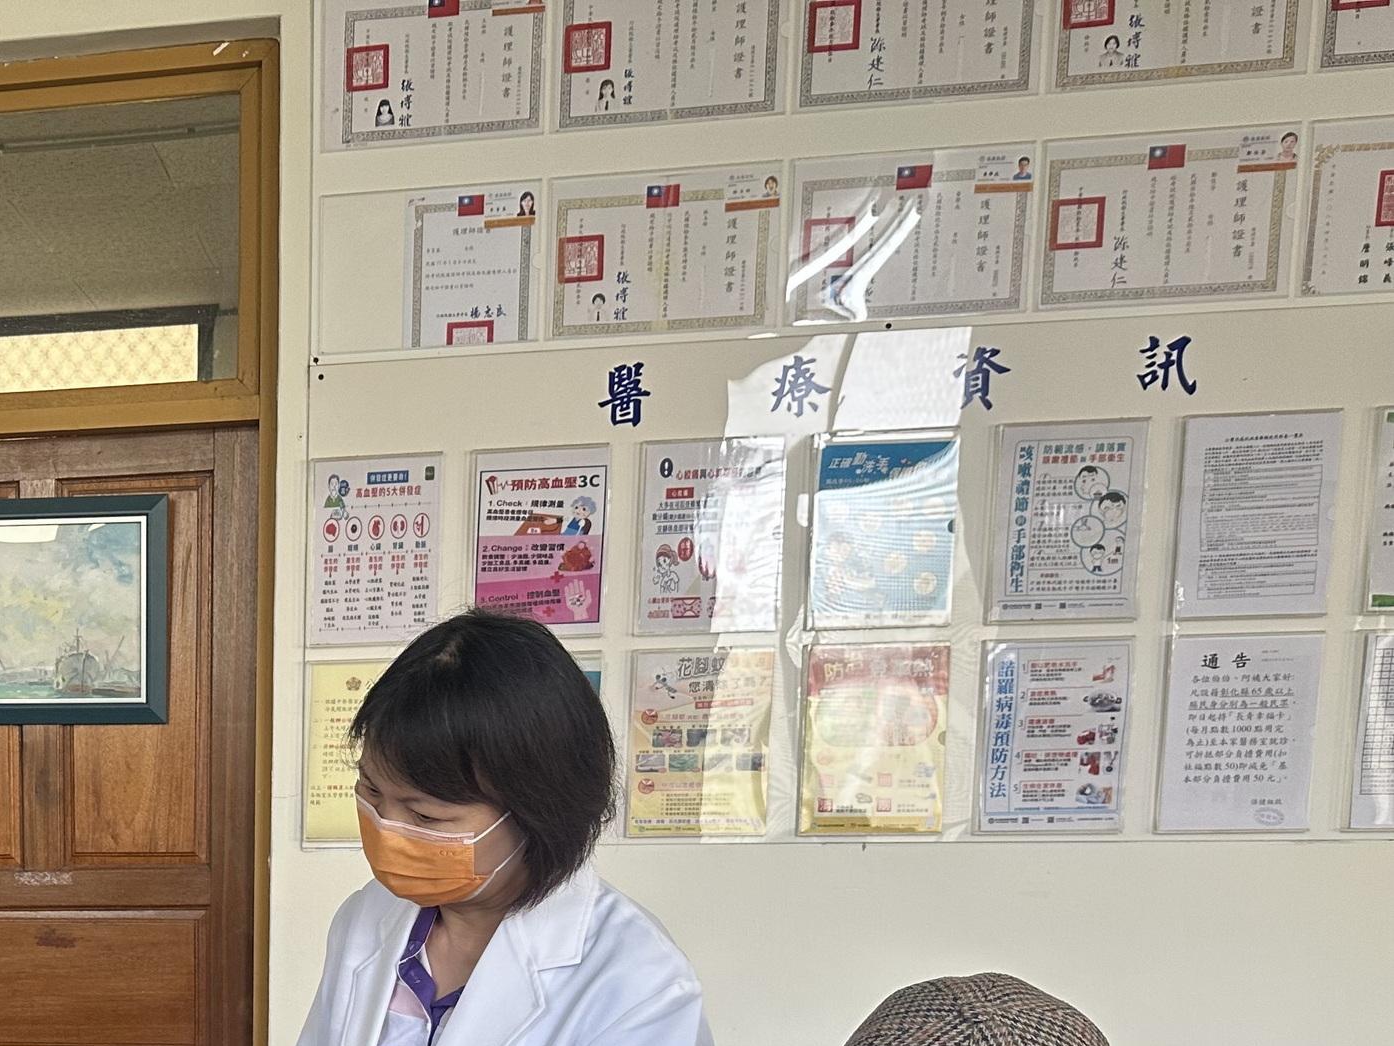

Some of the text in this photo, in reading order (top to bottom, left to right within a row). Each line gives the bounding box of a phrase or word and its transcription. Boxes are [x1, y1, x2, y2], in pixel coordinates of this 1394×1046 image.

[1232, 178, 1249, 258] 護理師證書
[511, 475, 601, 491] 預防高血壓3C
